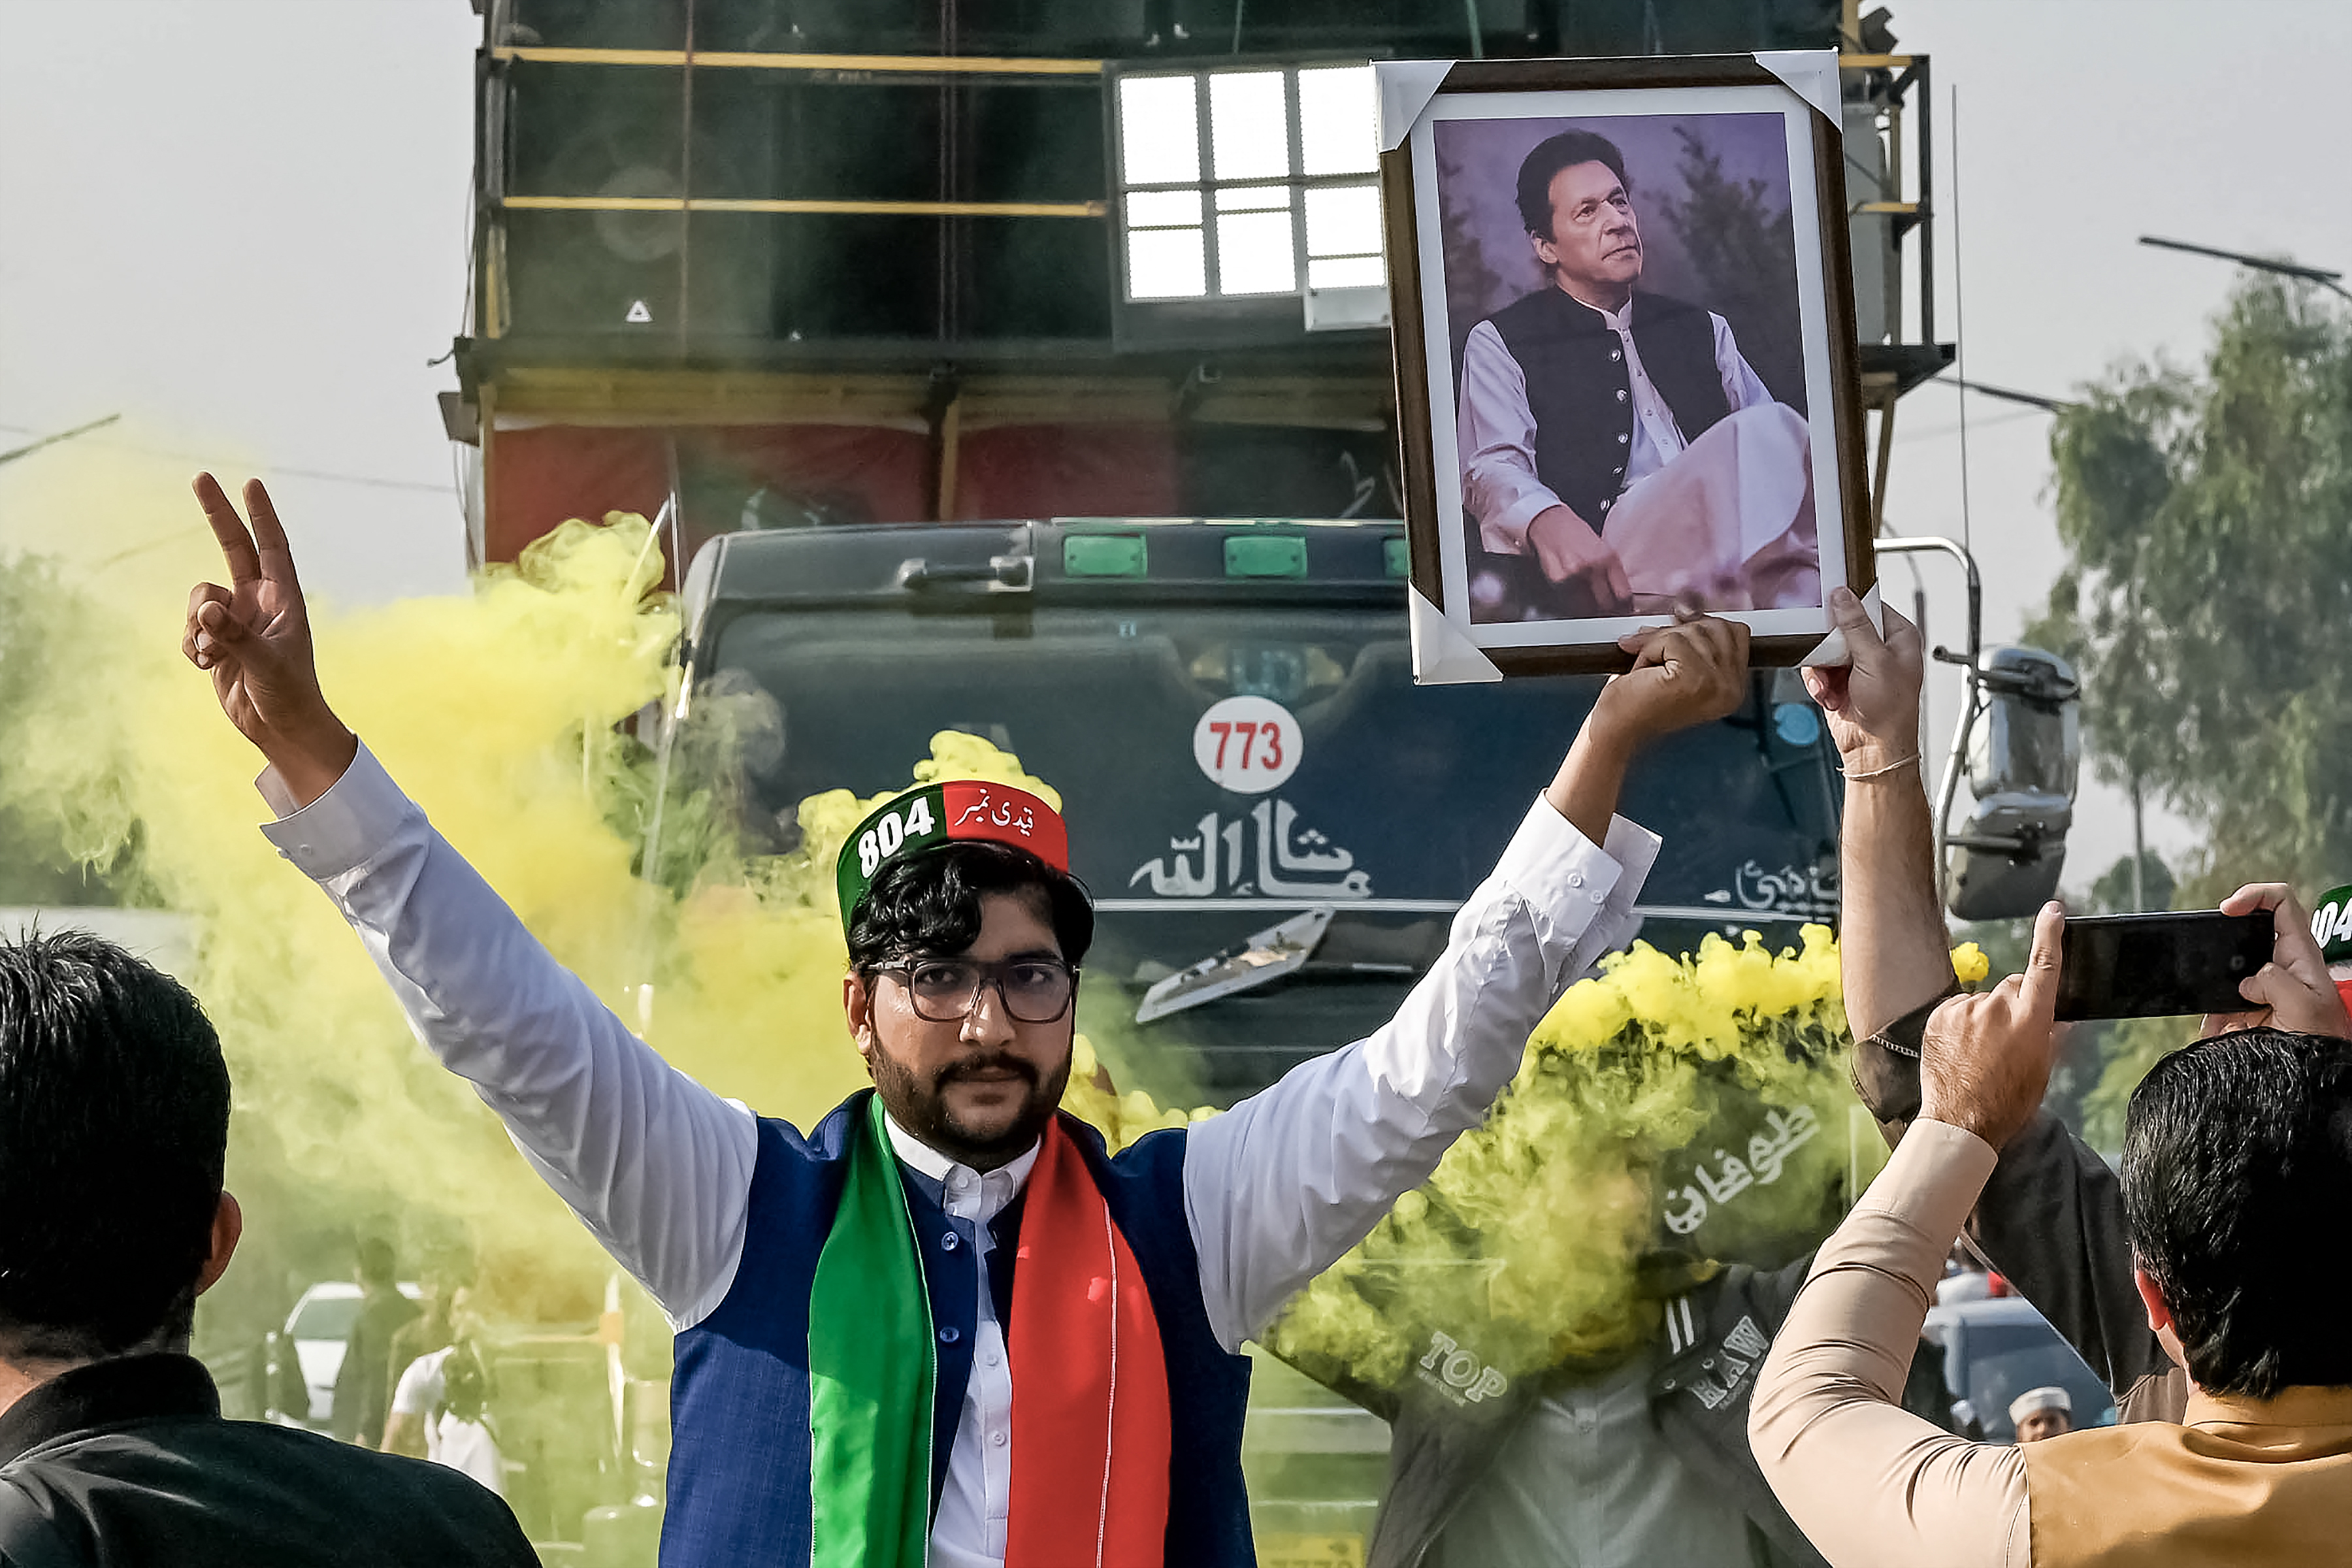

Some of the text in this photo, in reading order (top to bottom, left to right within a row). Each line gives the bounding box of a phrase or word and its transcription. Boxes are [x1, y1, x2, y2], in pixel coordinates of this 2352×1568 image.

[1209, 721, 1282, 770] 773
[858, 796, 935, 879] 804
[1665, 1104, 1821, 1234] طوفان
[1419, 1330, 1508, 1403] TOP
